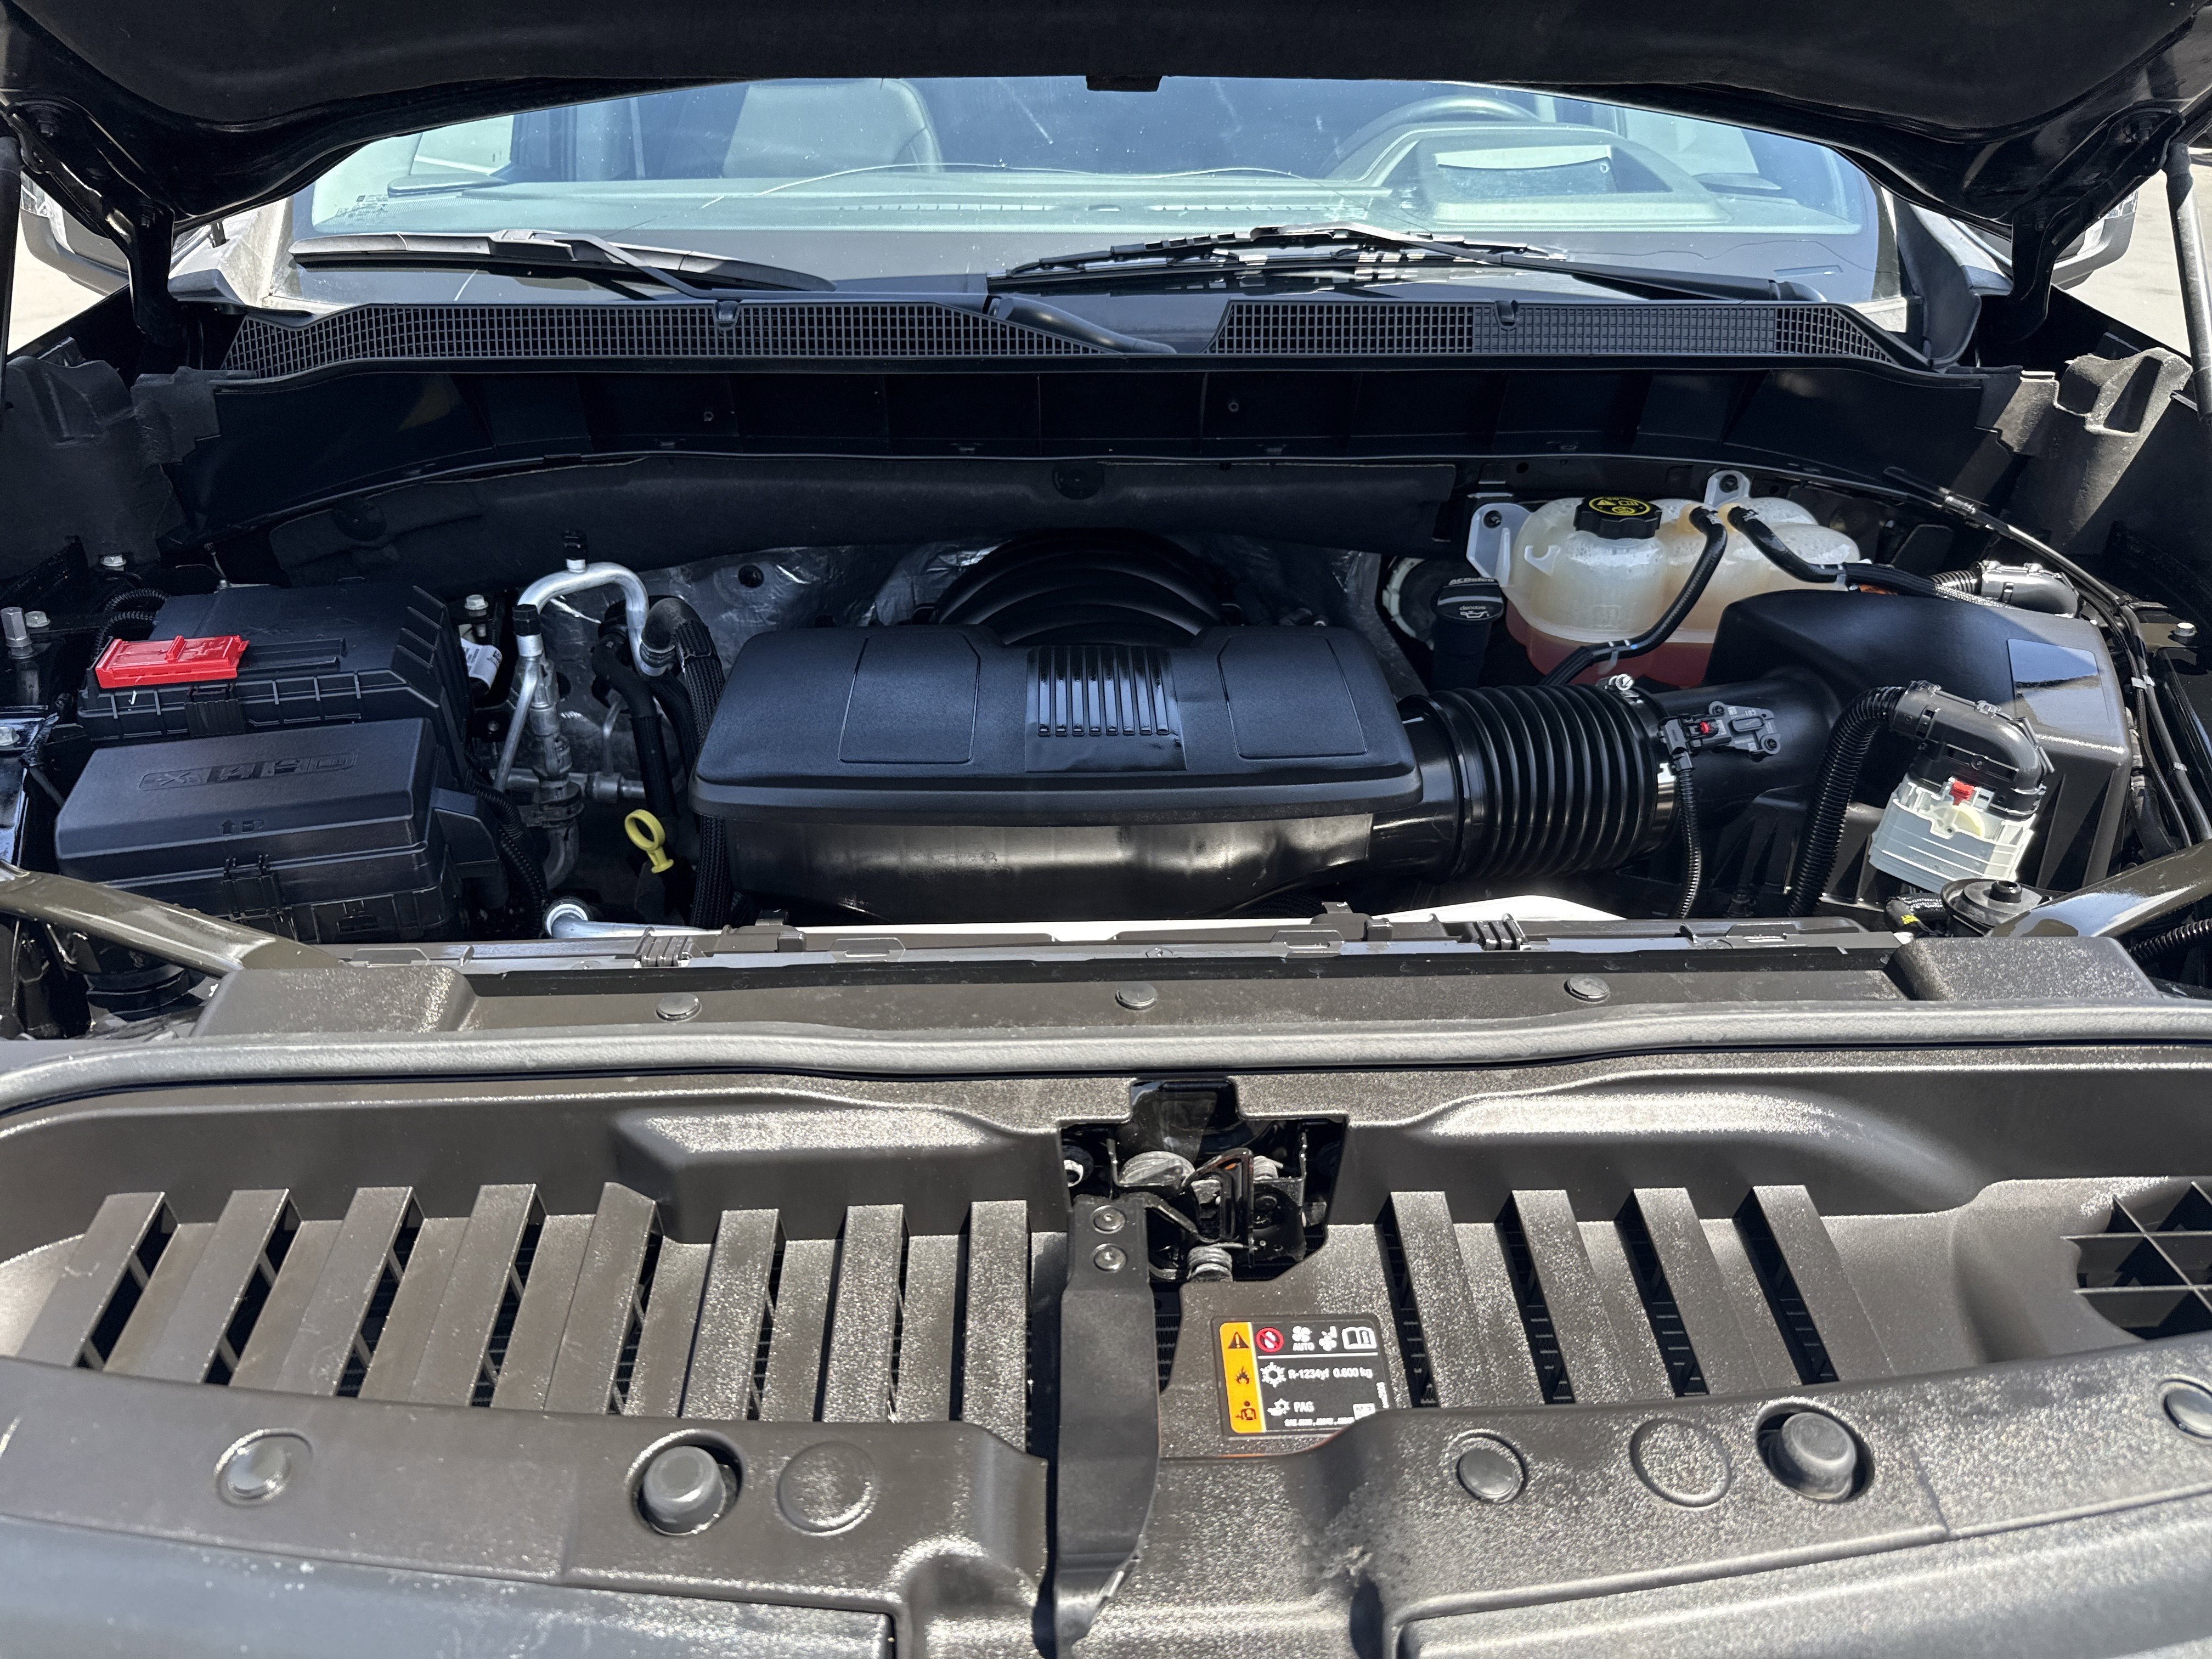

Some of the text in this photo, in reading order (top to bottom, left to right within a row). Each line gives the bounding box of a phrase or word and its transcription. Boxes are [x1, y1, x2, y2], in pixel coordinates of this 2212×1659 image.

[1293, 1342, 1314, 1351] AUTO
[1288, 1367, 1373, 1380] R-1234yf 0.600 kg
[1294, 1401, 1314, 1412] PAG
